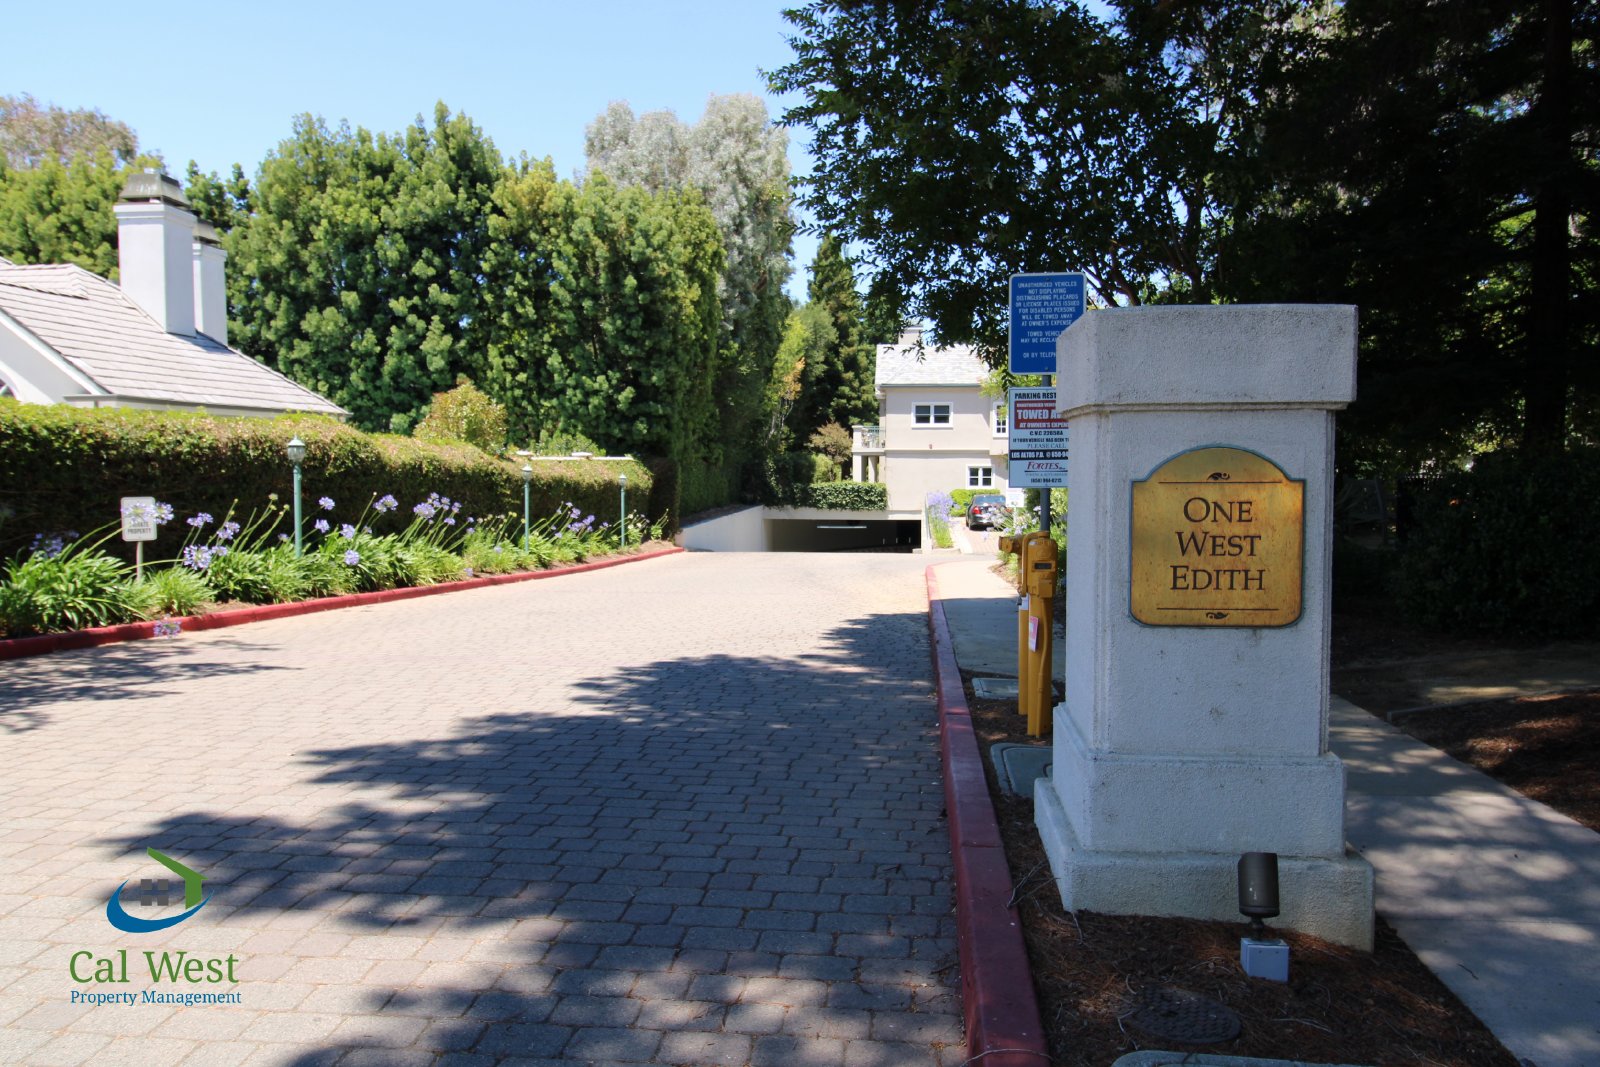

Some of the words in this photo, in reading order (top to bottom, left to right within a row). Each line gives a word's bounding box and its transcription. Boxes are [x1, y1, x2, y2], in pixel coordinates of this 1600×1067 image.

[1017, 410, 1048, 419] TOWED
[1183, 497, 1253, 523] ONE
[1175, 532, 1262, 557] WEST
[1169, 565, 1266, 591] EDITH
